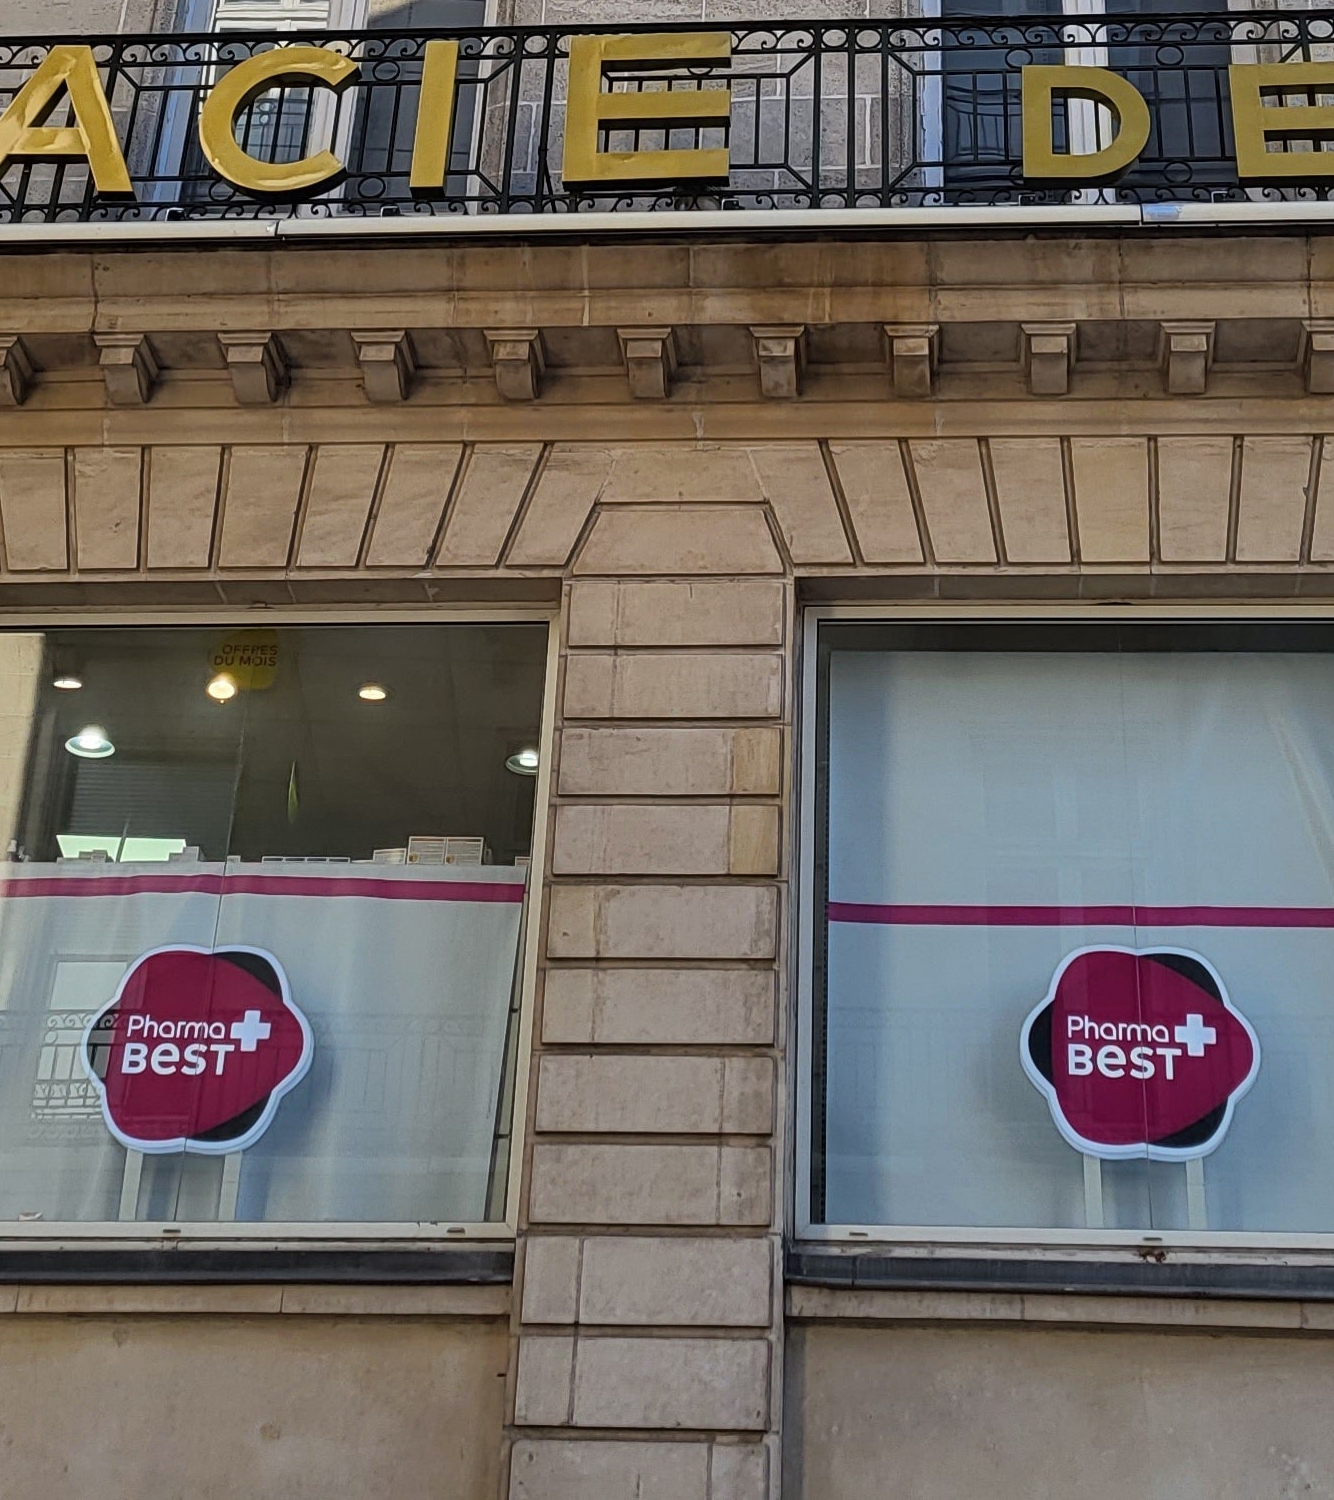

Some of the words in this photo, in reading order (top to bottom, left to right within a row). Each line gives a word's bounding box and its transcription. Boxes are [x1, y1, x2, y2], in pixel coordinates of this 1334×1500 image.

[213, 655, 234, 666] DU
[239, 656, 276, 667] MOIS
[126, 1014, 225, 1039] Pharma
[1067, 1015, 1169, 1043] Pharma
